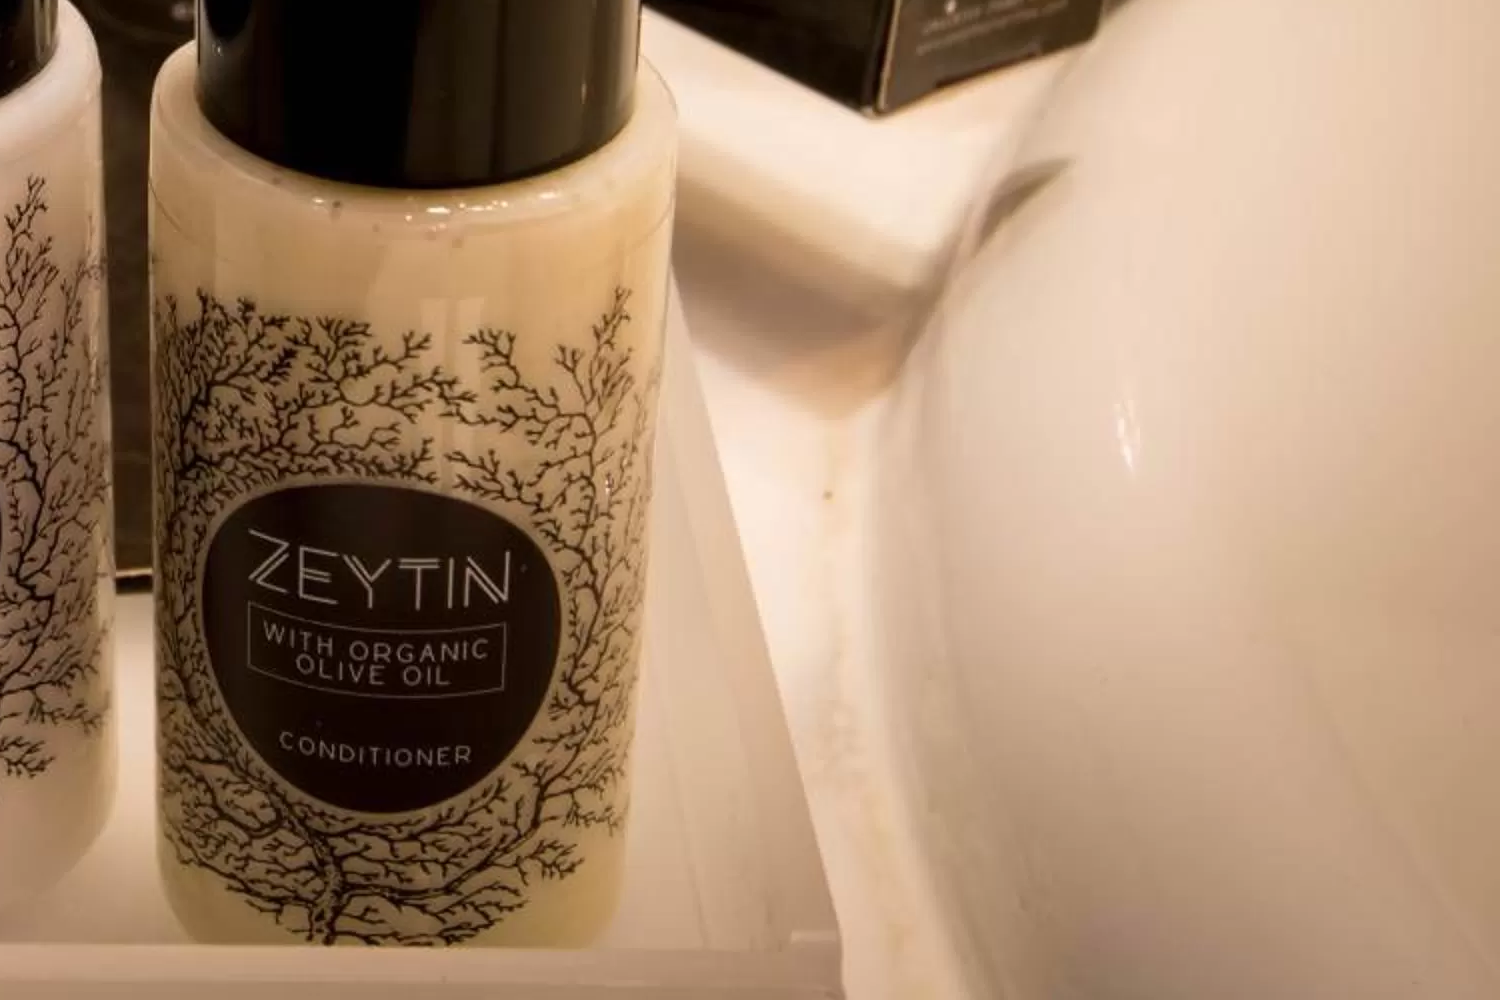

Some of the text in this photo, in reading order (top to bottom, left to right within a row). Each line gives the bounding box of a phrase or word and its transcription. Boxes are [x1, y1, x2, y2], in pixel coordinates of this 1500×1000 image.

[247, 527, 512, 611] ZEYTIN
[262, 618, 490, 665] WITH ORGANIC
[294, 654, 452, 687] OLIVE OIL
[278, 730, 473, 768] CONDITIONER
